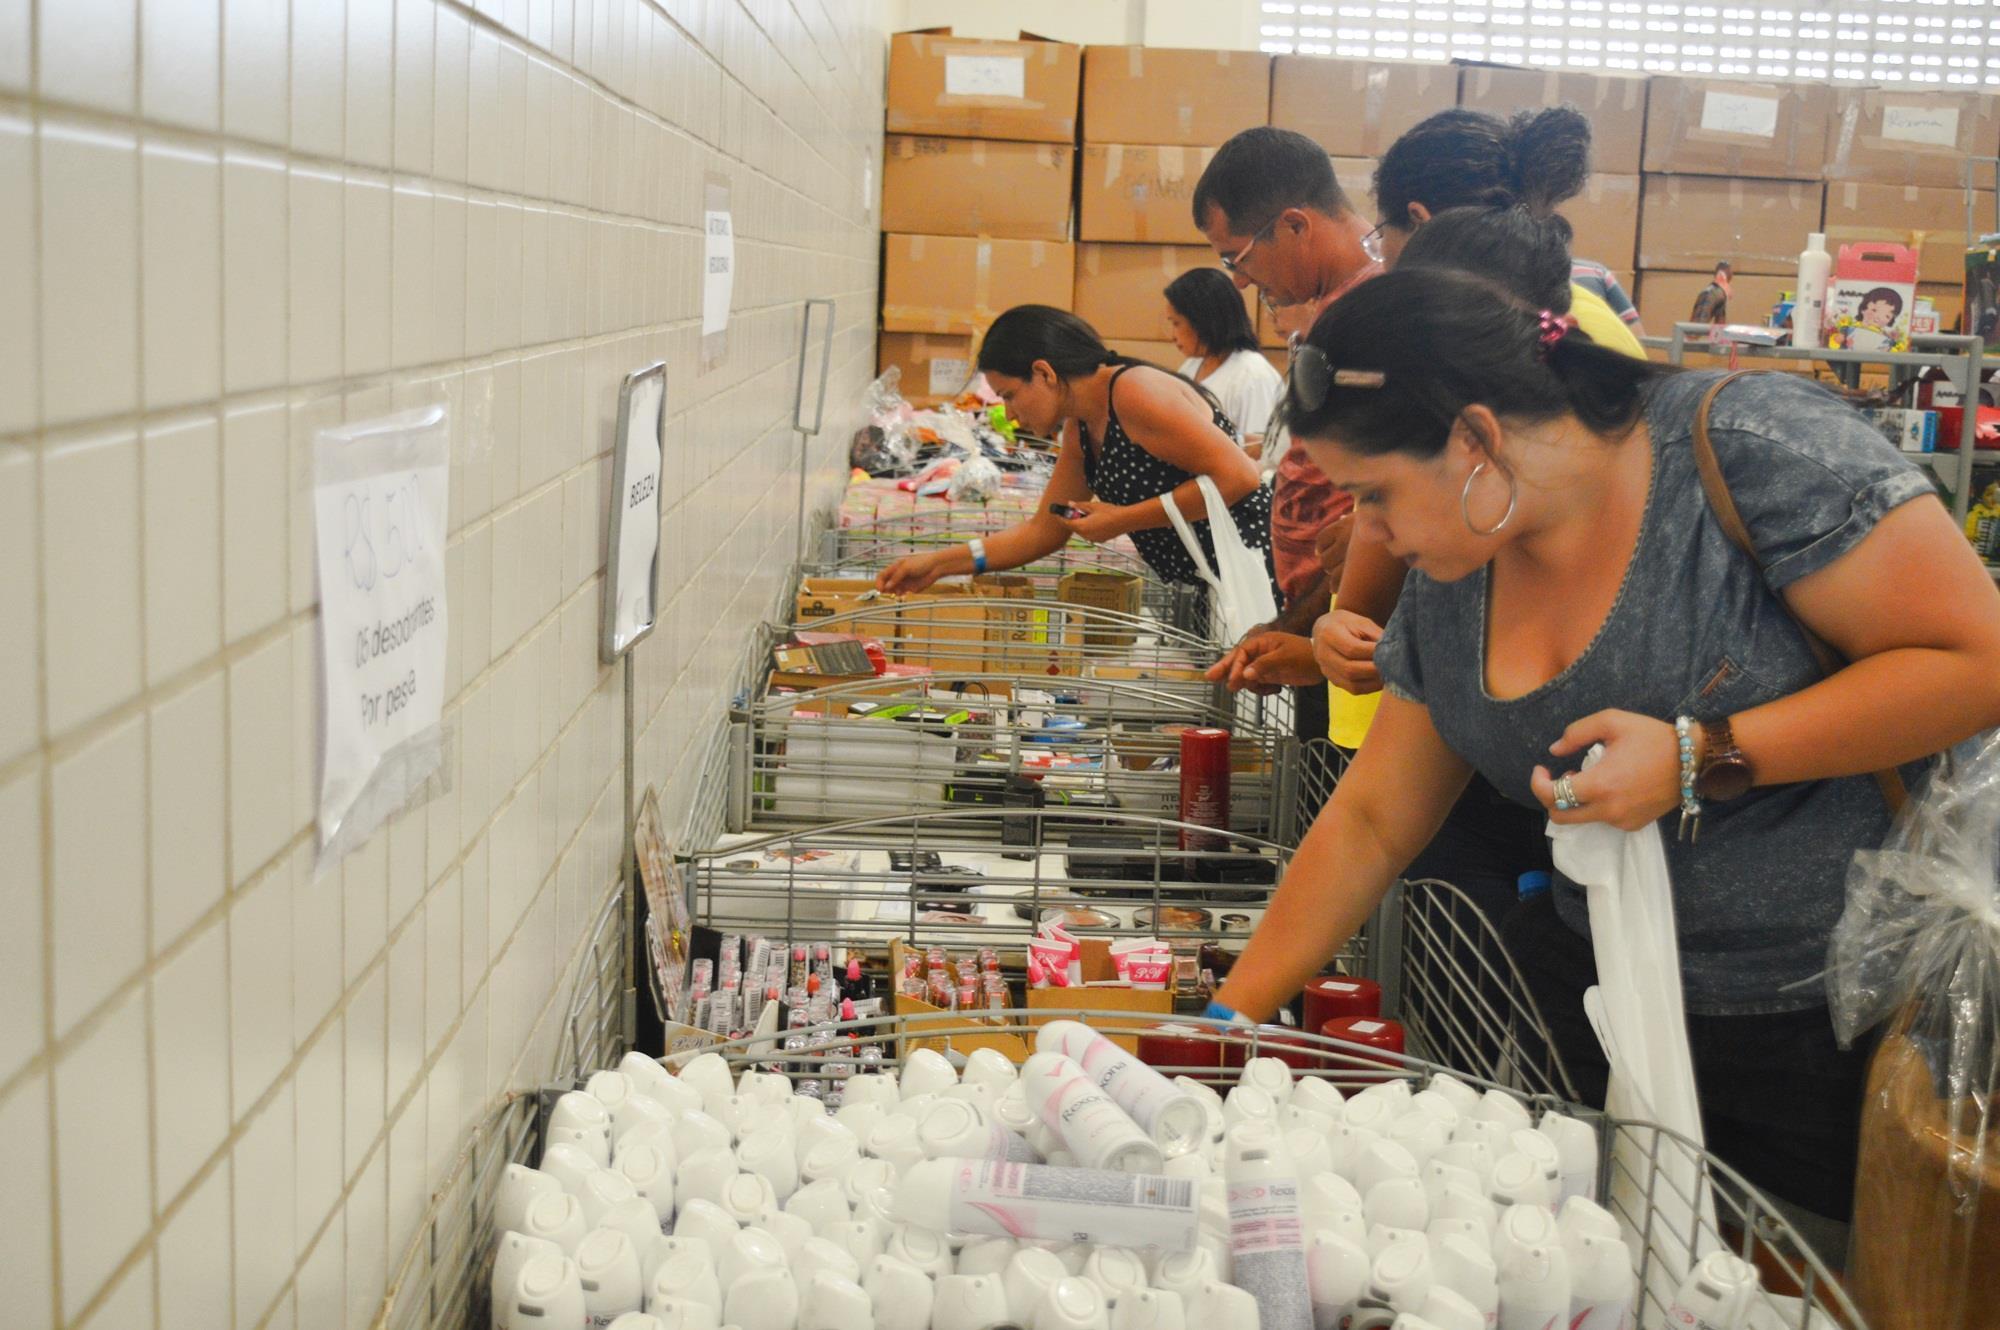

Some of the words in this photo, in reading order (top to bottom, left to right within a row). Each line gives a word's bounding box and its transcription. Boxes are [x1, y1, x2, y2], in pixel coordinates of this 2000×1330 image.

[630, 472, 655, 509] BELEZA
[361, 692, 383, 733] Por
[1134, 967, 1166, 979] P&W
[1099, 1061, 1127, 1089] xona
